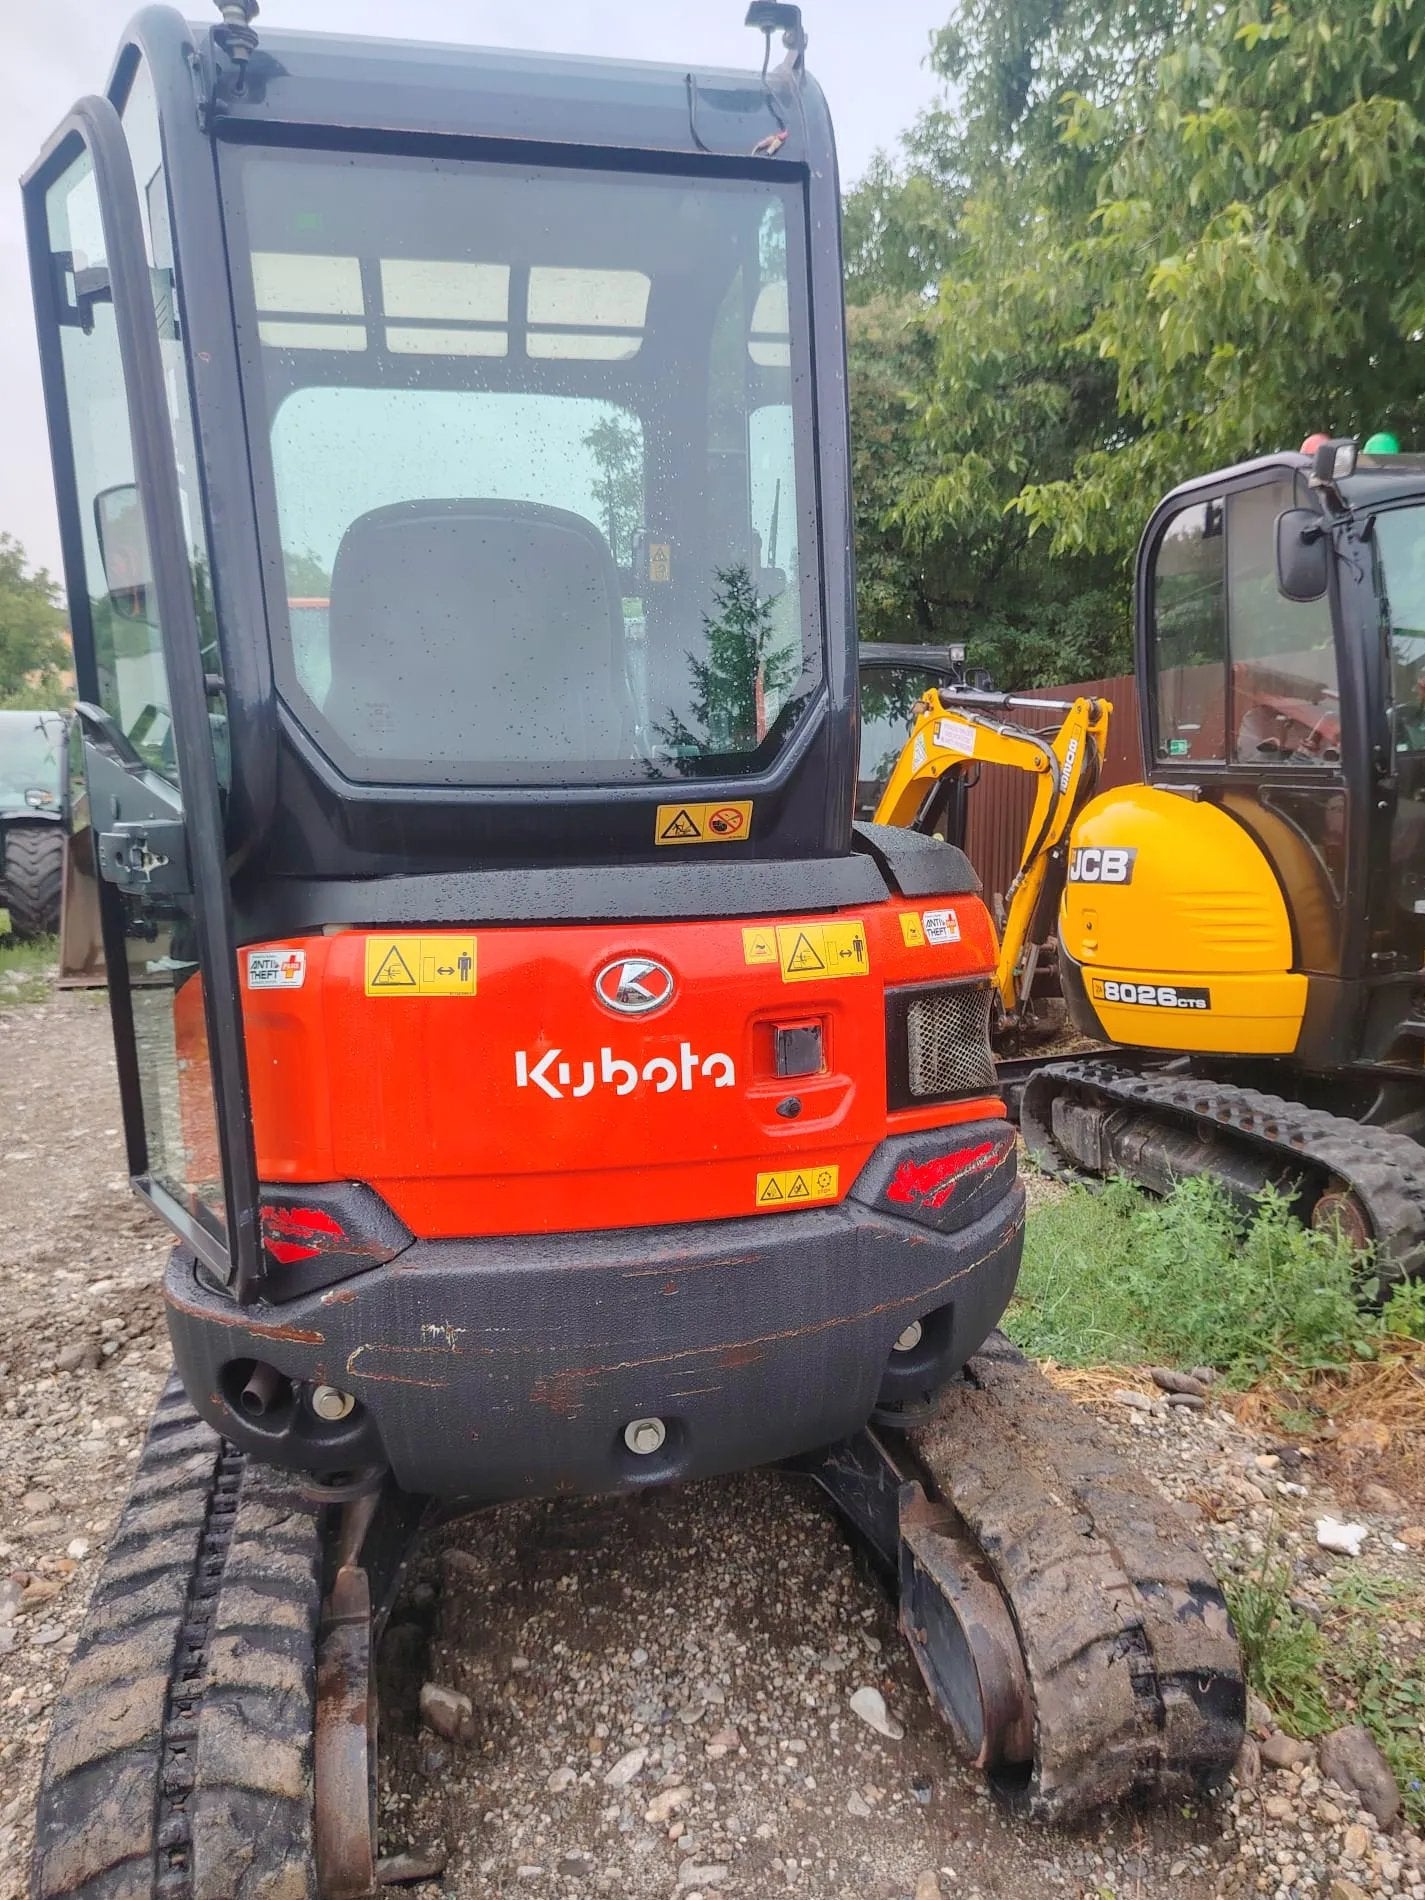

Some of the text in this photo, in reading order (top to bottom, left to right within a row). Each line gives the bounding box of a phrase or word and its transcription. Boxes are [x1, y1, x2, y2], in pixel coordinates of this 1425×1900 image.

[1070, 849, 1129, 882] JCB
[250, 960, 273, 970] ANTI
[250, 970, 279, 980] THEFT
[515, 1042, 736, 1099] Kubota
